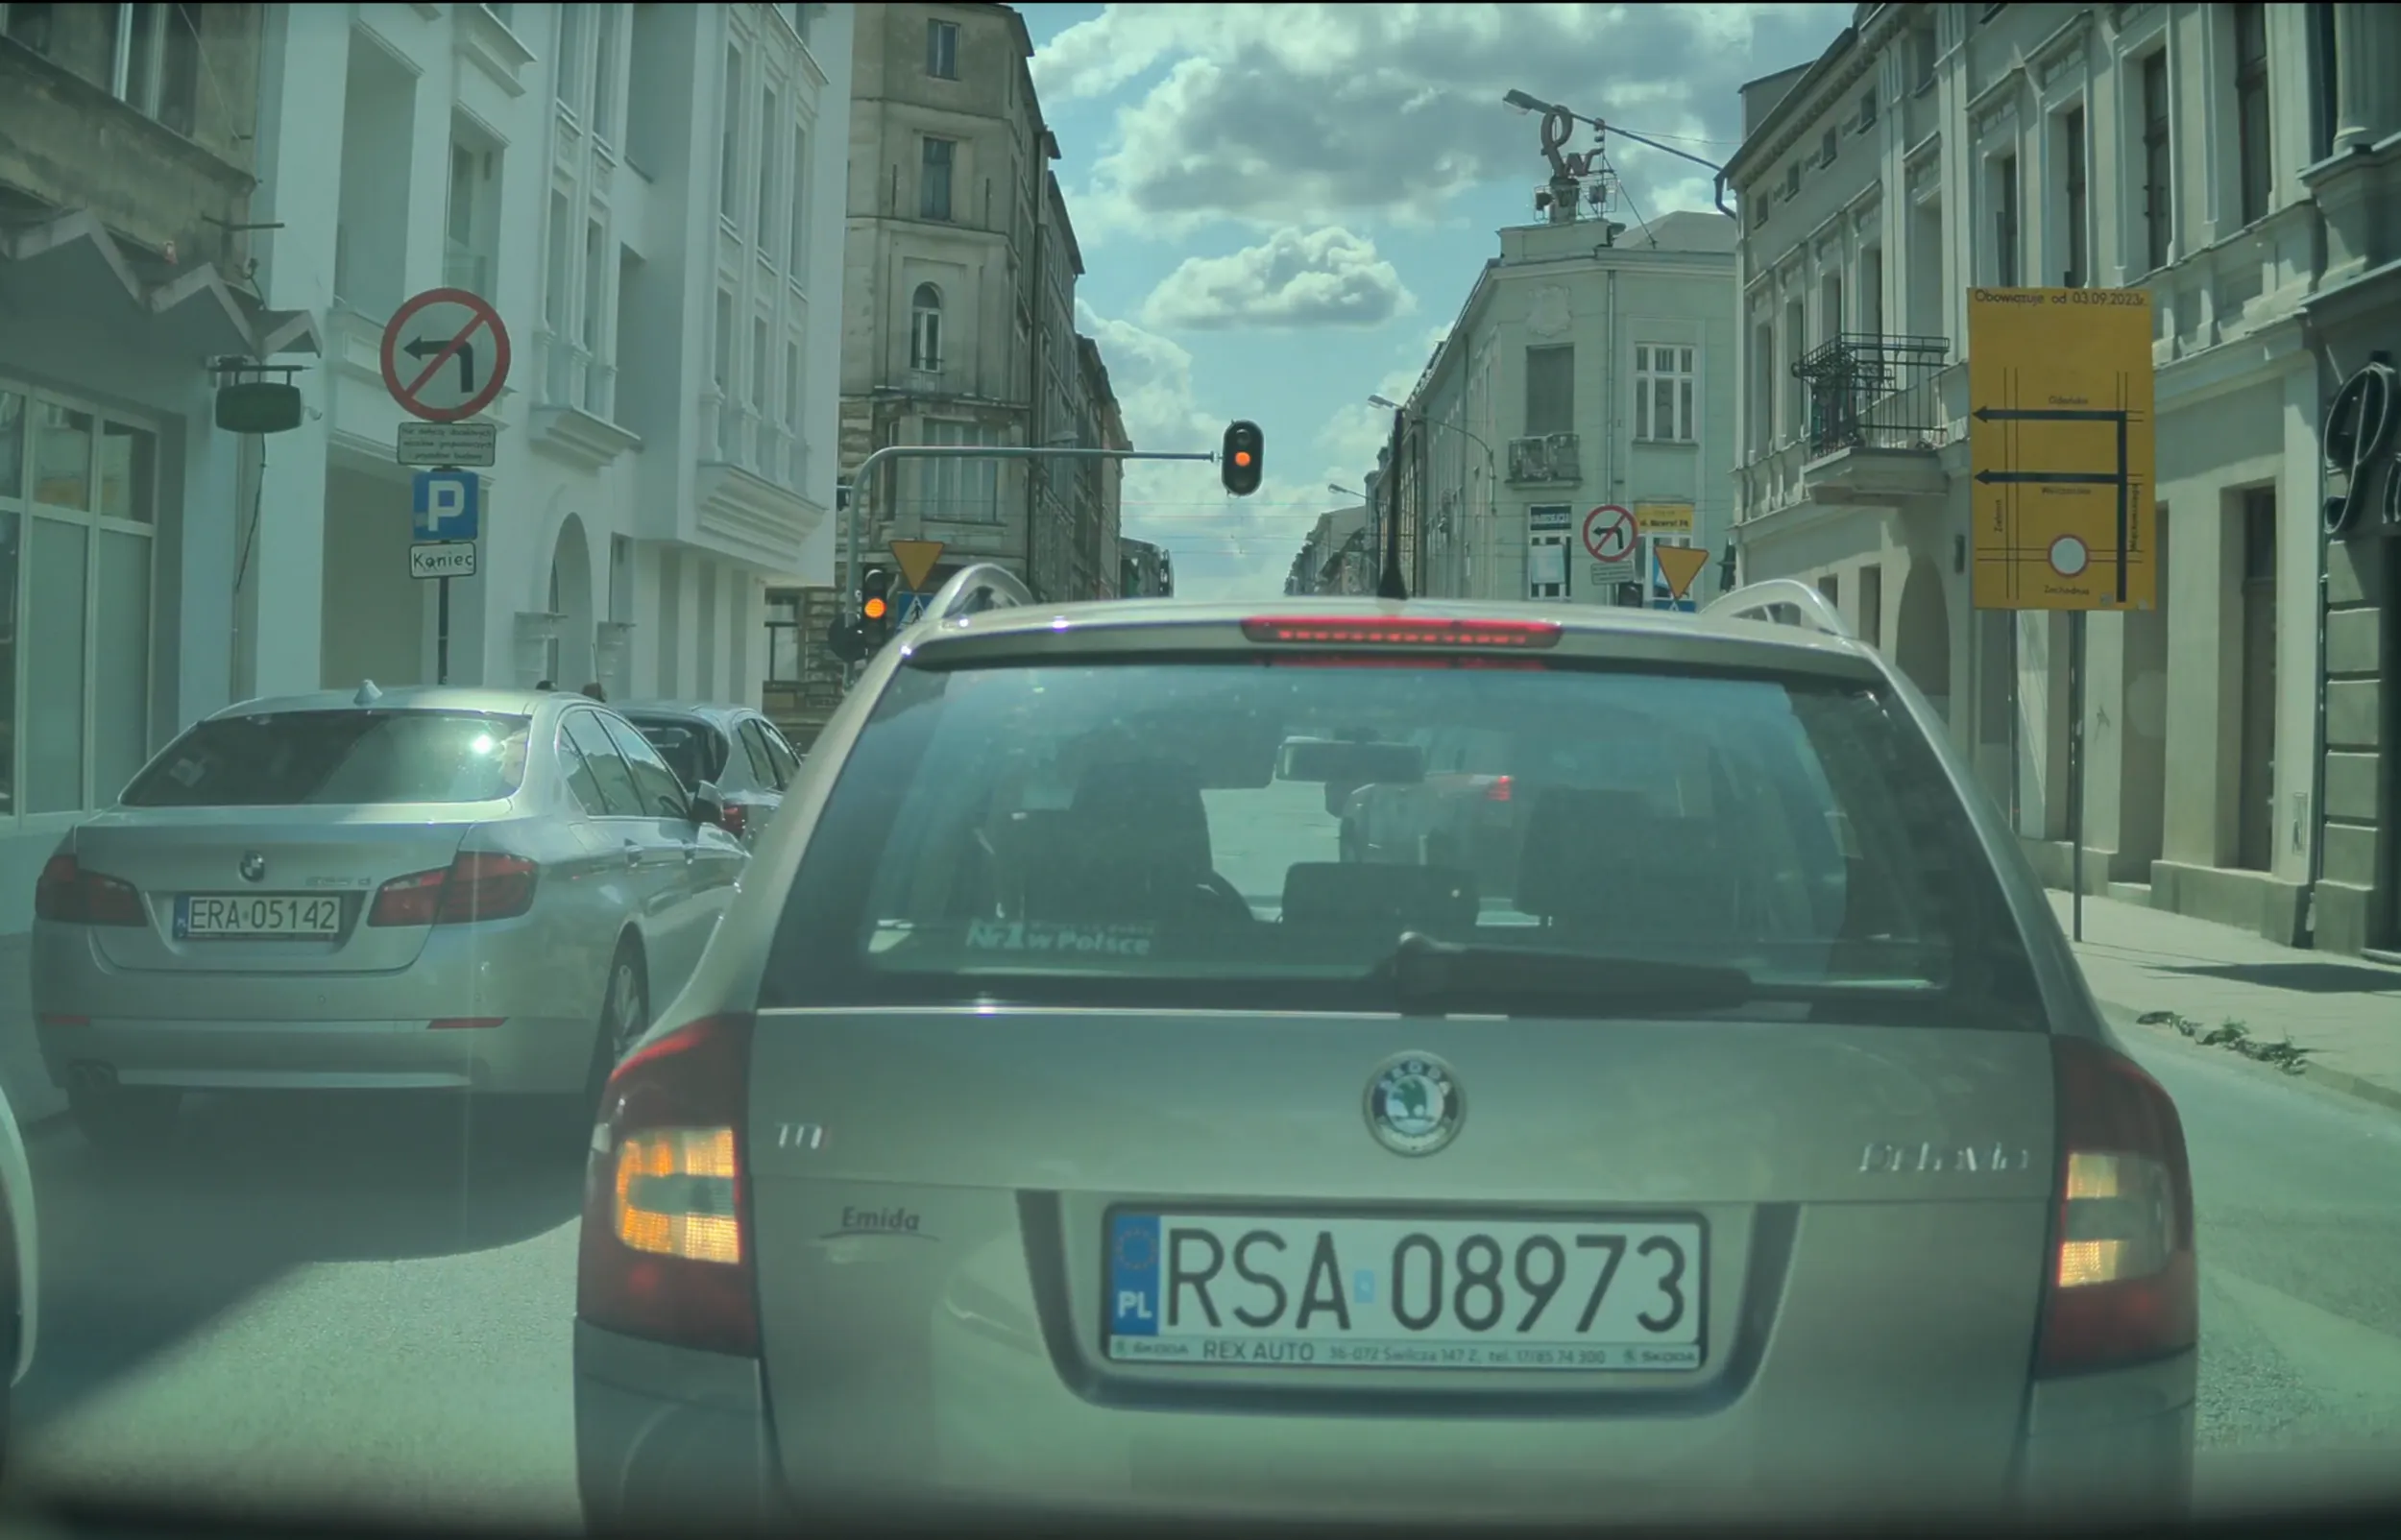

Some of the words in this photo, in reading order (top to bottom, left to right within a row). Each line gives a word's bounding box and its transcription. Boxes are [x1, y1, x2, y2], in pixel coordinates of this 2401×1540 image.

[2051, 292, 2068, 304] od
[427, 480, 465, 532] P
[413, 553, 473, 568] Koniec
[191, 899, 240, 929] ERA
[251, 901, 336, 930] 05142
[842, 1206, 920, 1231] Emida
[1167, 1228, 1352, 1331] RSA
[1390, 1232, 1686, 1334] 08973
[1118, 1292, 1152, 1319] PL
[1202, 1340, 1247, 1360] REX
[1252, 1341, 1315, 1361] AUTO
